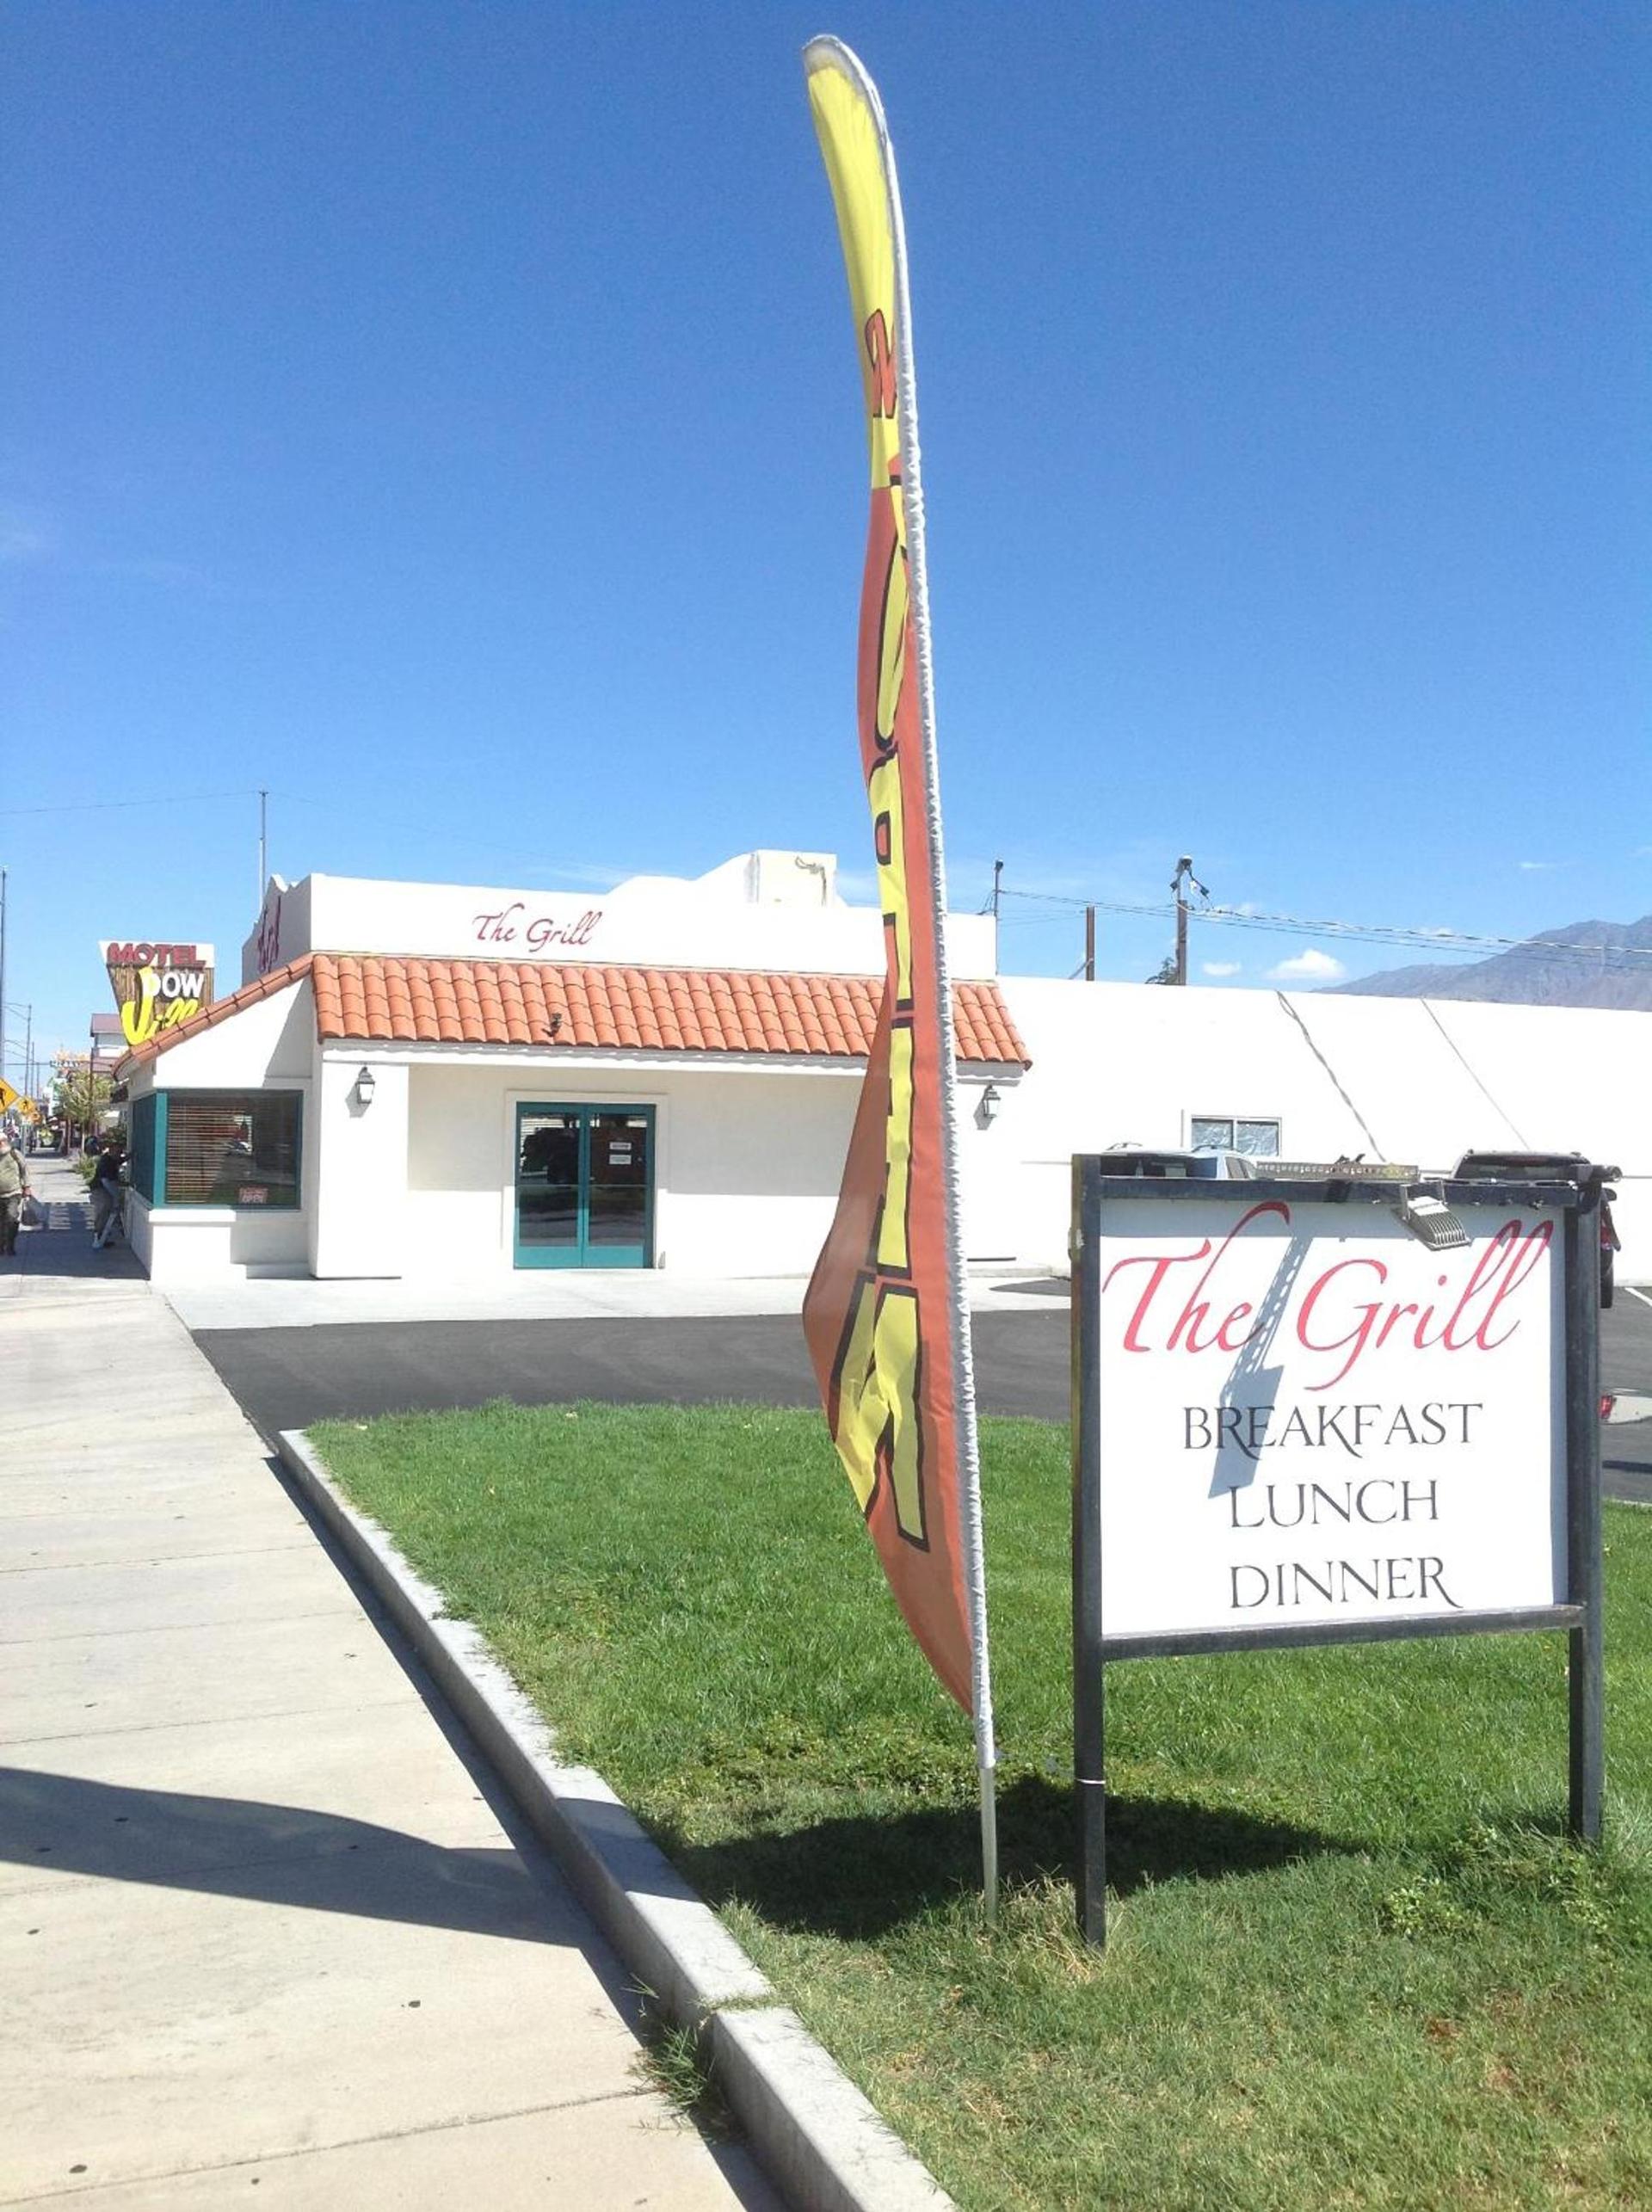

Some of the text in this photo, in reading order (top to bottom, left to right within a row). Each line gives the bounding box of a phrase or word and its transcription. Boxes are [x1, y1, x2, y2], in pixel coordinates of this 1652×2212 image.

[472, 903, 602, 952] The Grill
[107, 942, 206, 969] MOTEL
[1101, 1200, 1554, 1392] The Grill
[1182, 1402, 1483, 1461] BREAKFAST
[1229, 1480, 1439, 1529] LUNCH
[1230, 1556, 1464, 1609] DINNER
